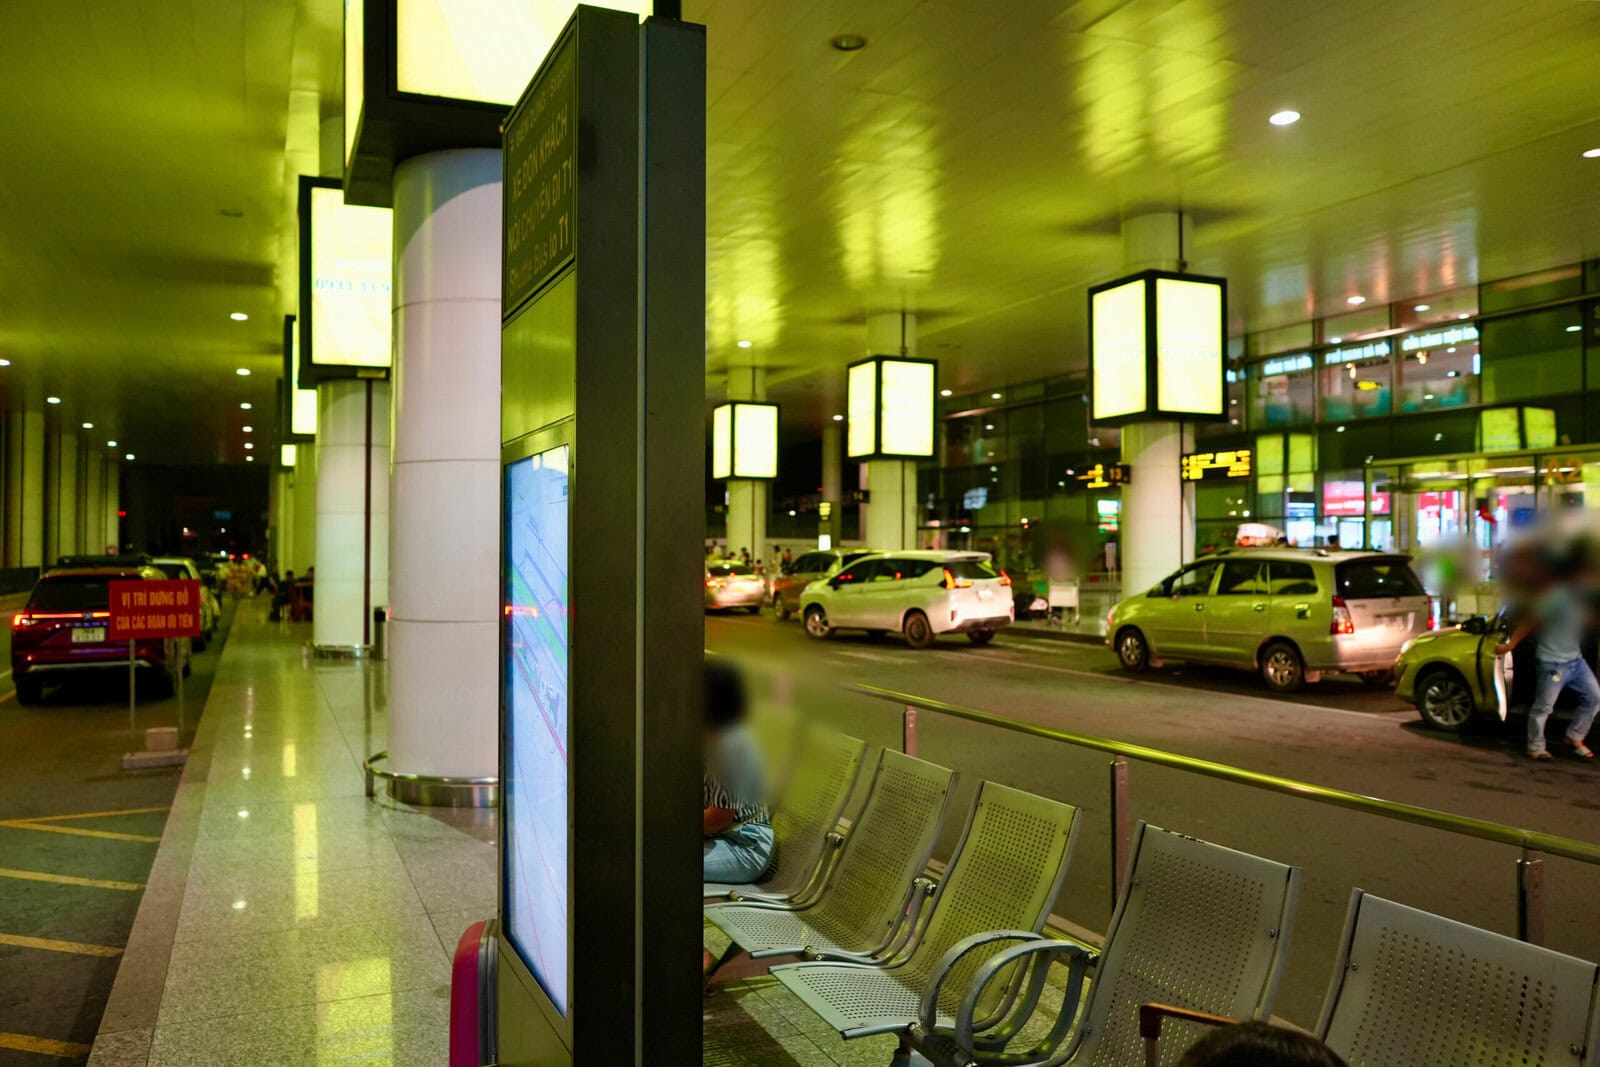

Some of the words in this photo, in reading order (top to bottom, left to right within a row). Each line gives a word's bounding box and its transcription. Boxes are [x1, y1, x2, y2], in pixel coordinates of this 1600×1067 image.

[539, 101, 568, 168] KHÁCH
[562, 154, 572, 196] T1
[559, 211, 569, 252] T1
[1109, 467, 1122, 480] 13
[1544, 456, 1584, 483] A2
